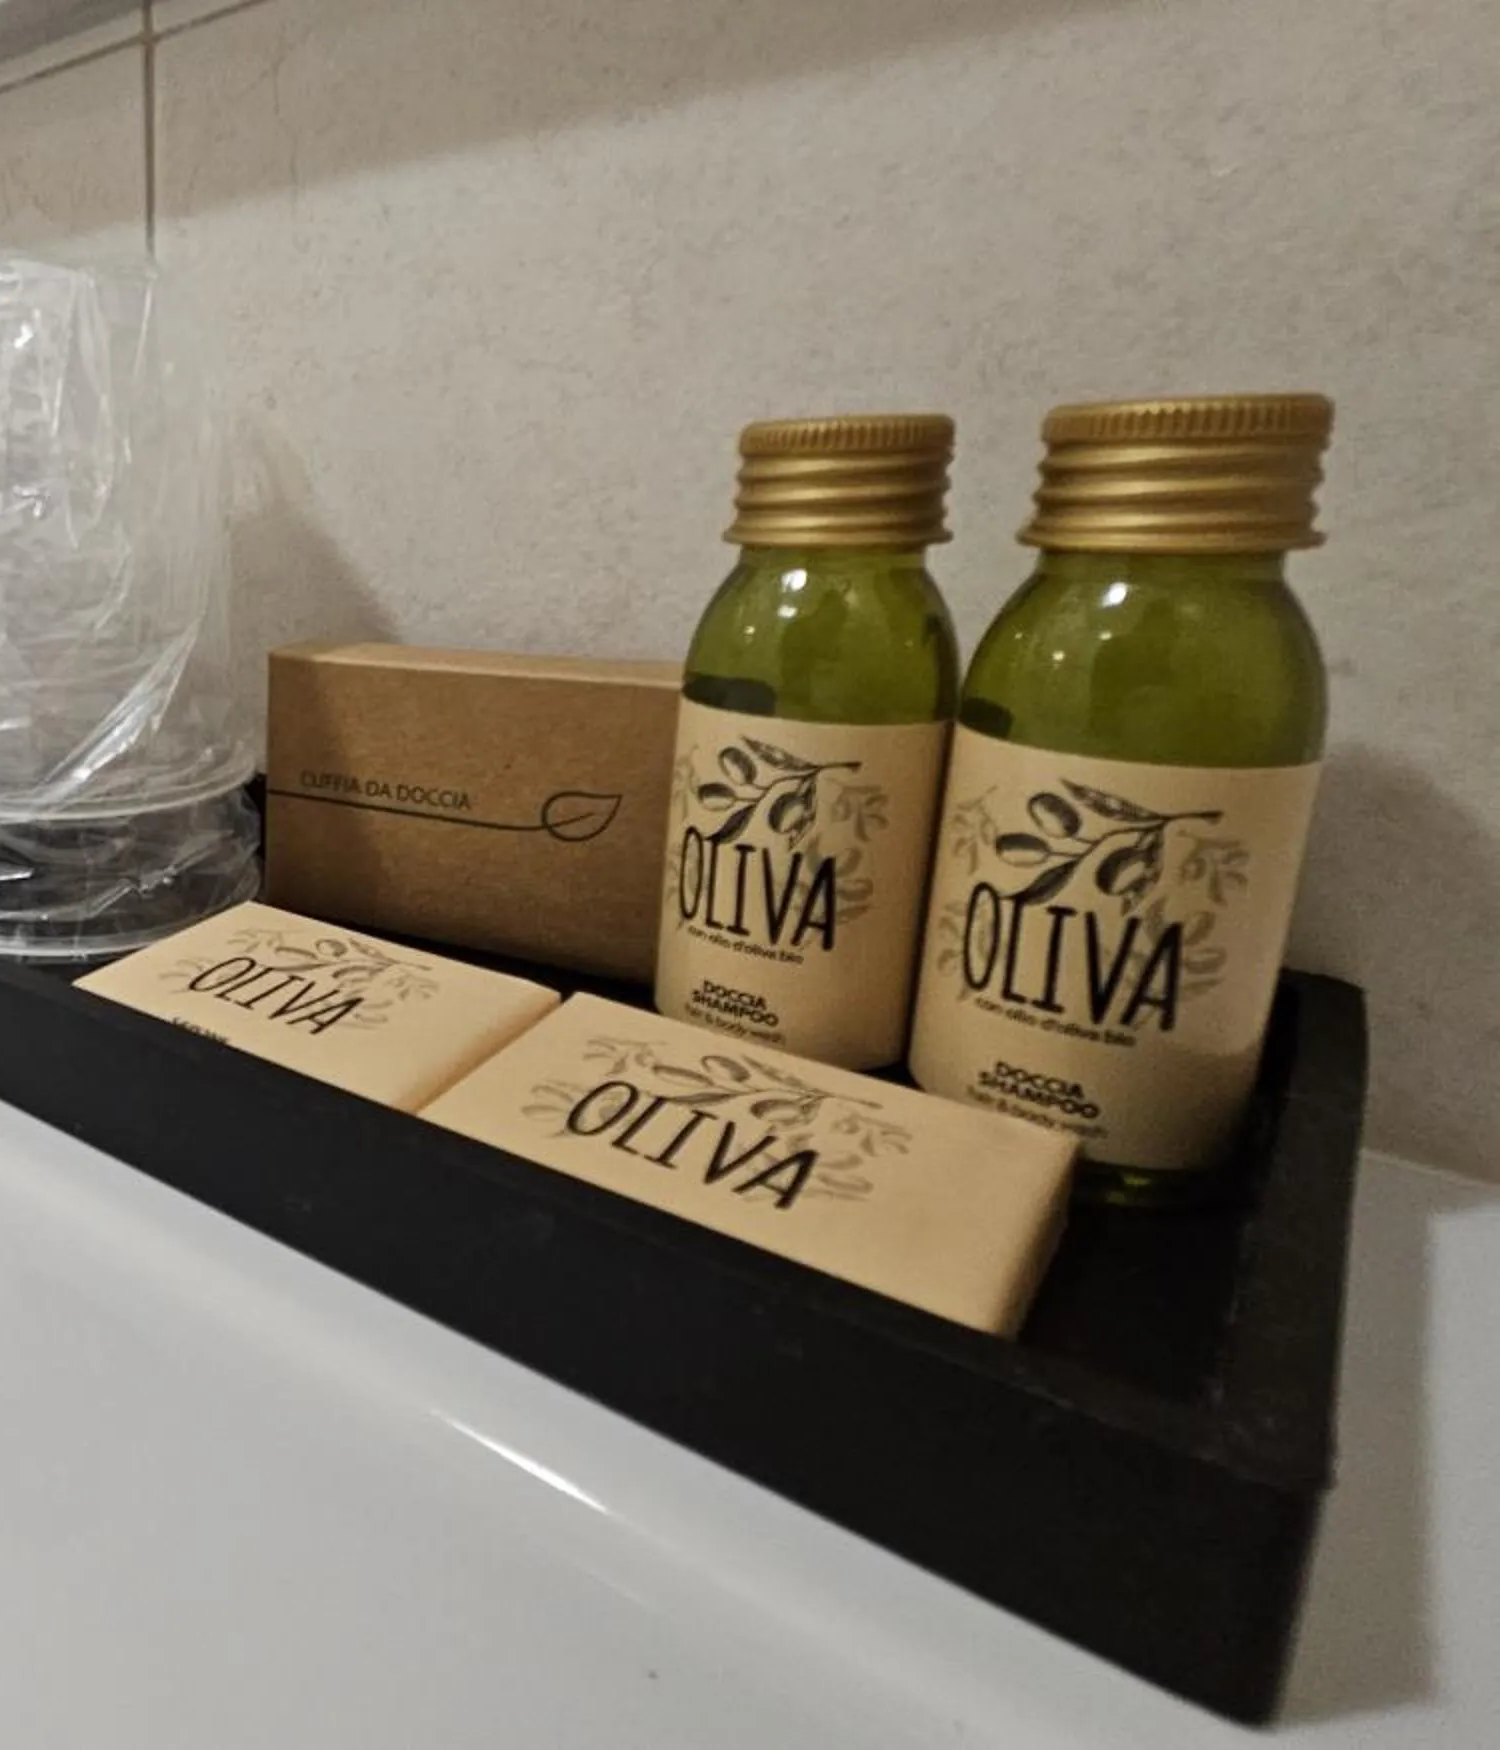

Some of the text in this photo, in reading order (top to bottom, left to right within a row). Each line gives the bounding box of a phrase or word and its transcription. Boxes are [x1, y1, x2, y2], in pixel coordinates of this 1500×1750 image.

[300, 770, 472, 811] CUFFIA DA DOCCIA
[679, 825, 837, 951] OLIVA
[963, 882, 1184, 1032] OLIVA
[187, 956, 365, 1036] OLIVA
[691, 988, 779, 1028] SHAMPOO
[703, 979, 767, 1011] DOCCIA
[979, 1071, 1100, 1119] SHAMPOO
[995, 1060, 1084, 1100] DOCCIA
[565, 1080, 821, 1211] OLIVA
